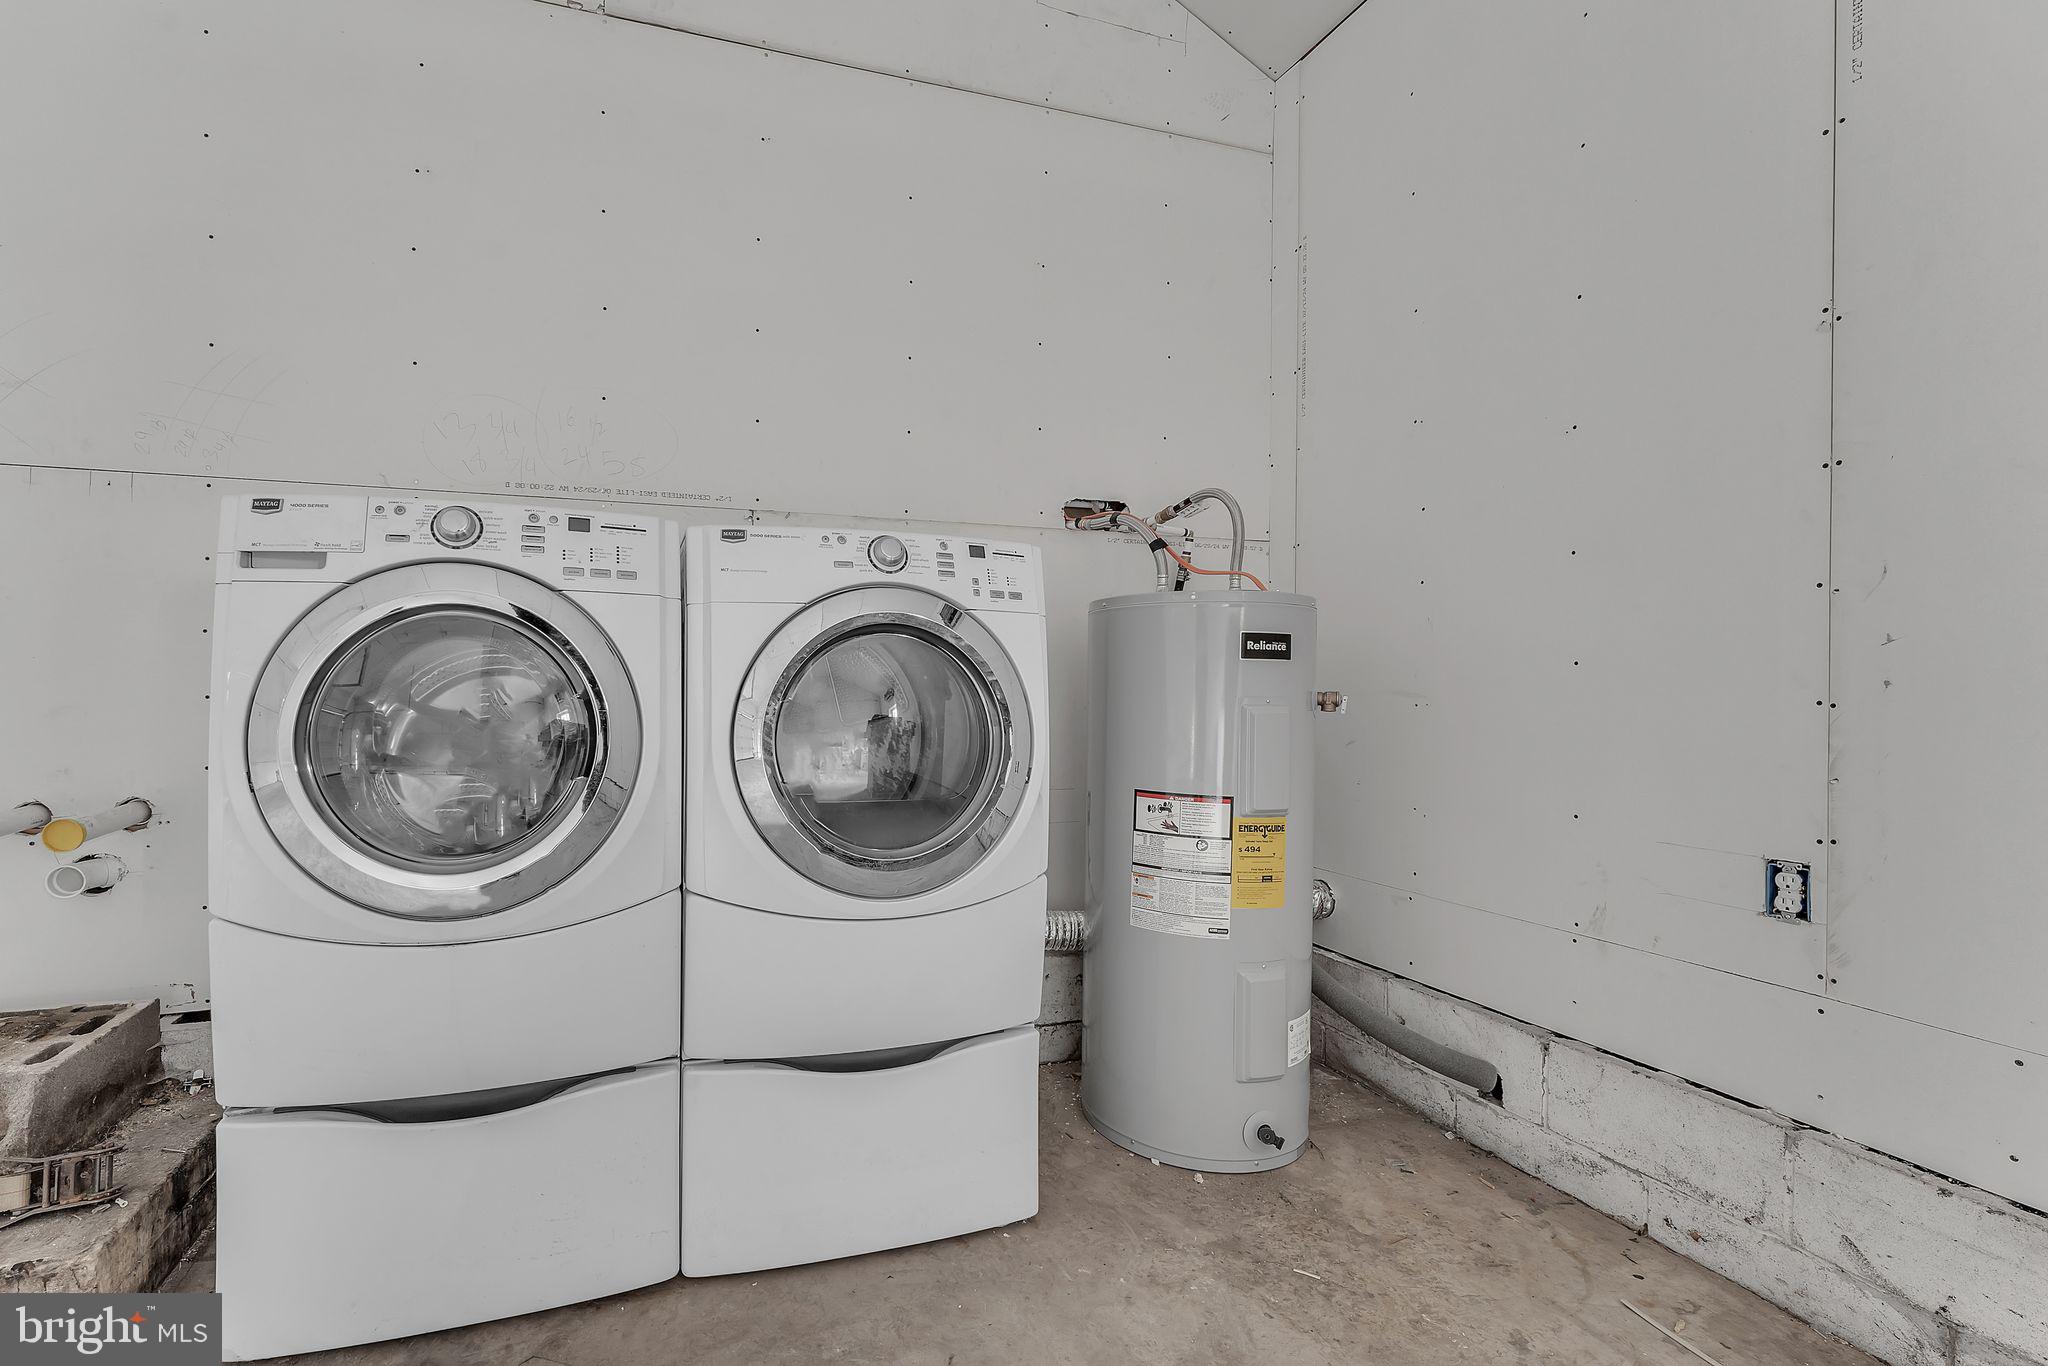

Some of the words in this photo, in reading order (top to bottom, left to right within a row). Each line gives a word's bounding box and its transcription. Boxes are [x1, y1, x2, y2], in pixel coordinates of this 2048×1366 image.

[253, 500, 280, 508] MAYTAG
[1246, 640, 1287, 651] Reliance
[1244, 845, 1261, 853] 494
